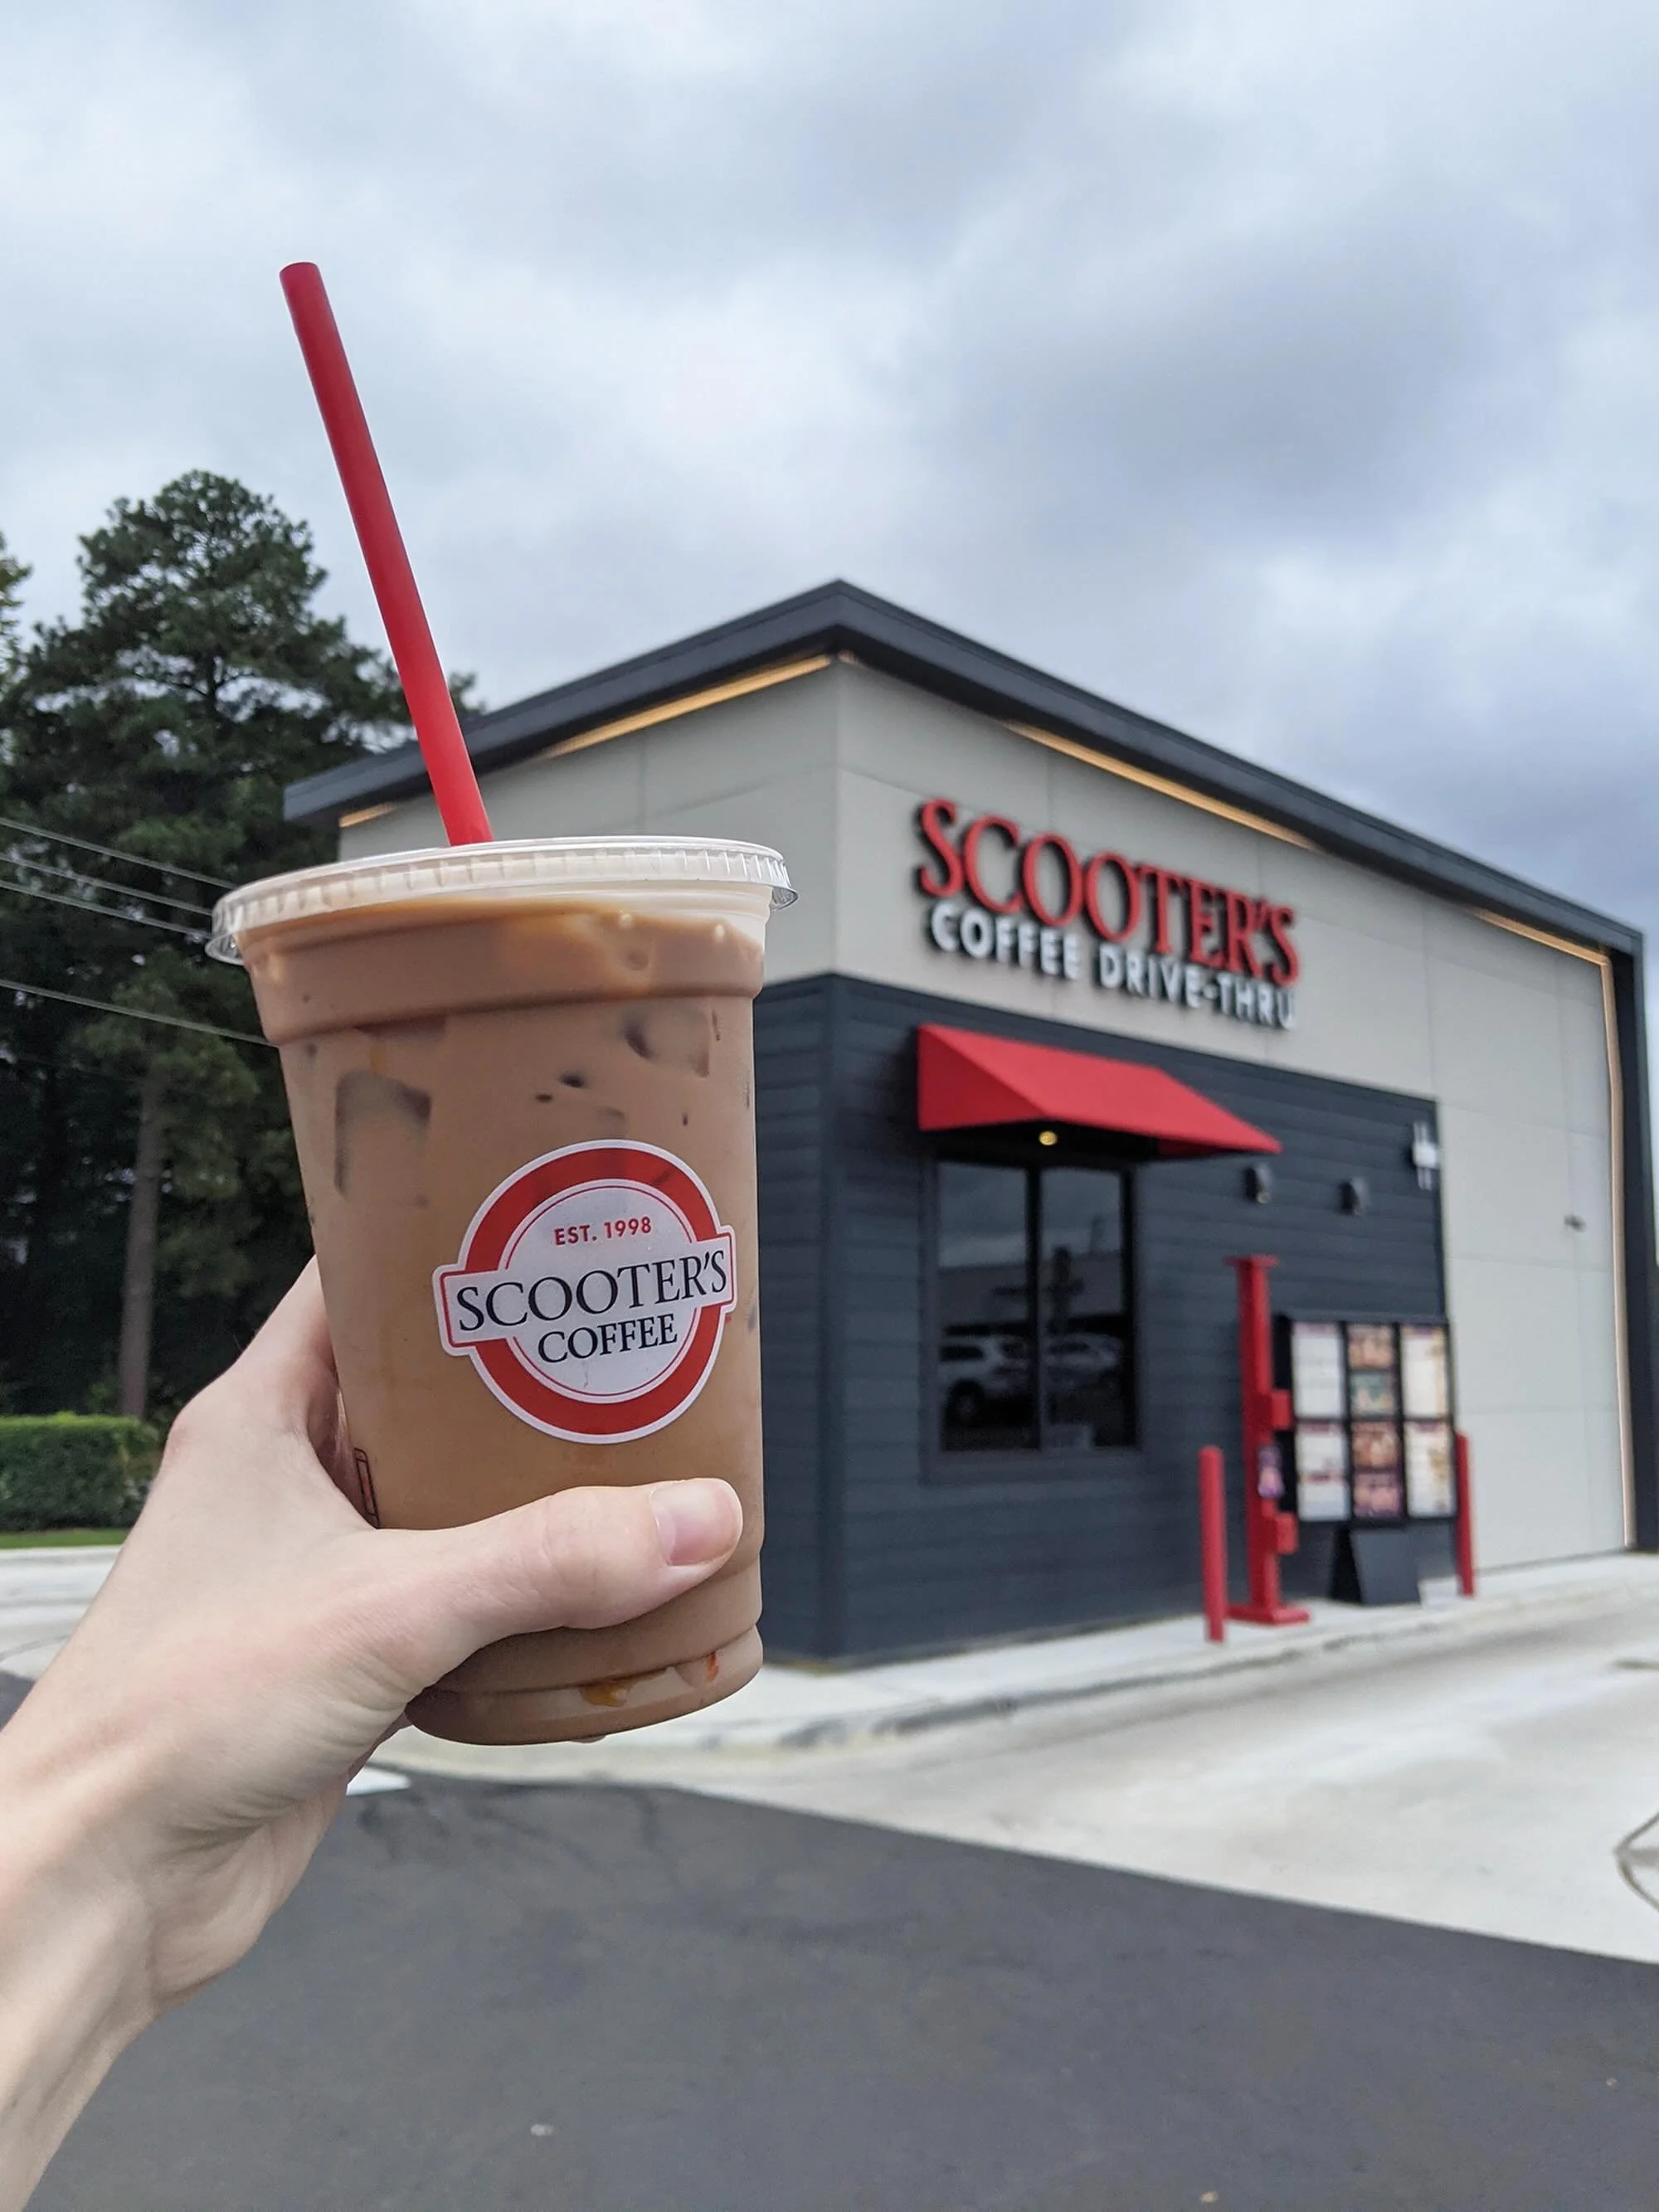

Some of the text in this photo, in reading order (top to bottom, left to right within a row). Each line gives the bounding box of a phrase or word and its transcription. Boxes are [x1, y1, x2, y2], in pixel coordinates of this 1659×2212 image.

[917, 798, 1299, 986] SCOOTER'S
[930, 902, 1079, 980] COFFEE
[554, 1216, 652, 1246] EST. 1998
[456, 1250, 727, 1331] SCOOTER'S
[538, 1314, 678, 1364] COFFEE
